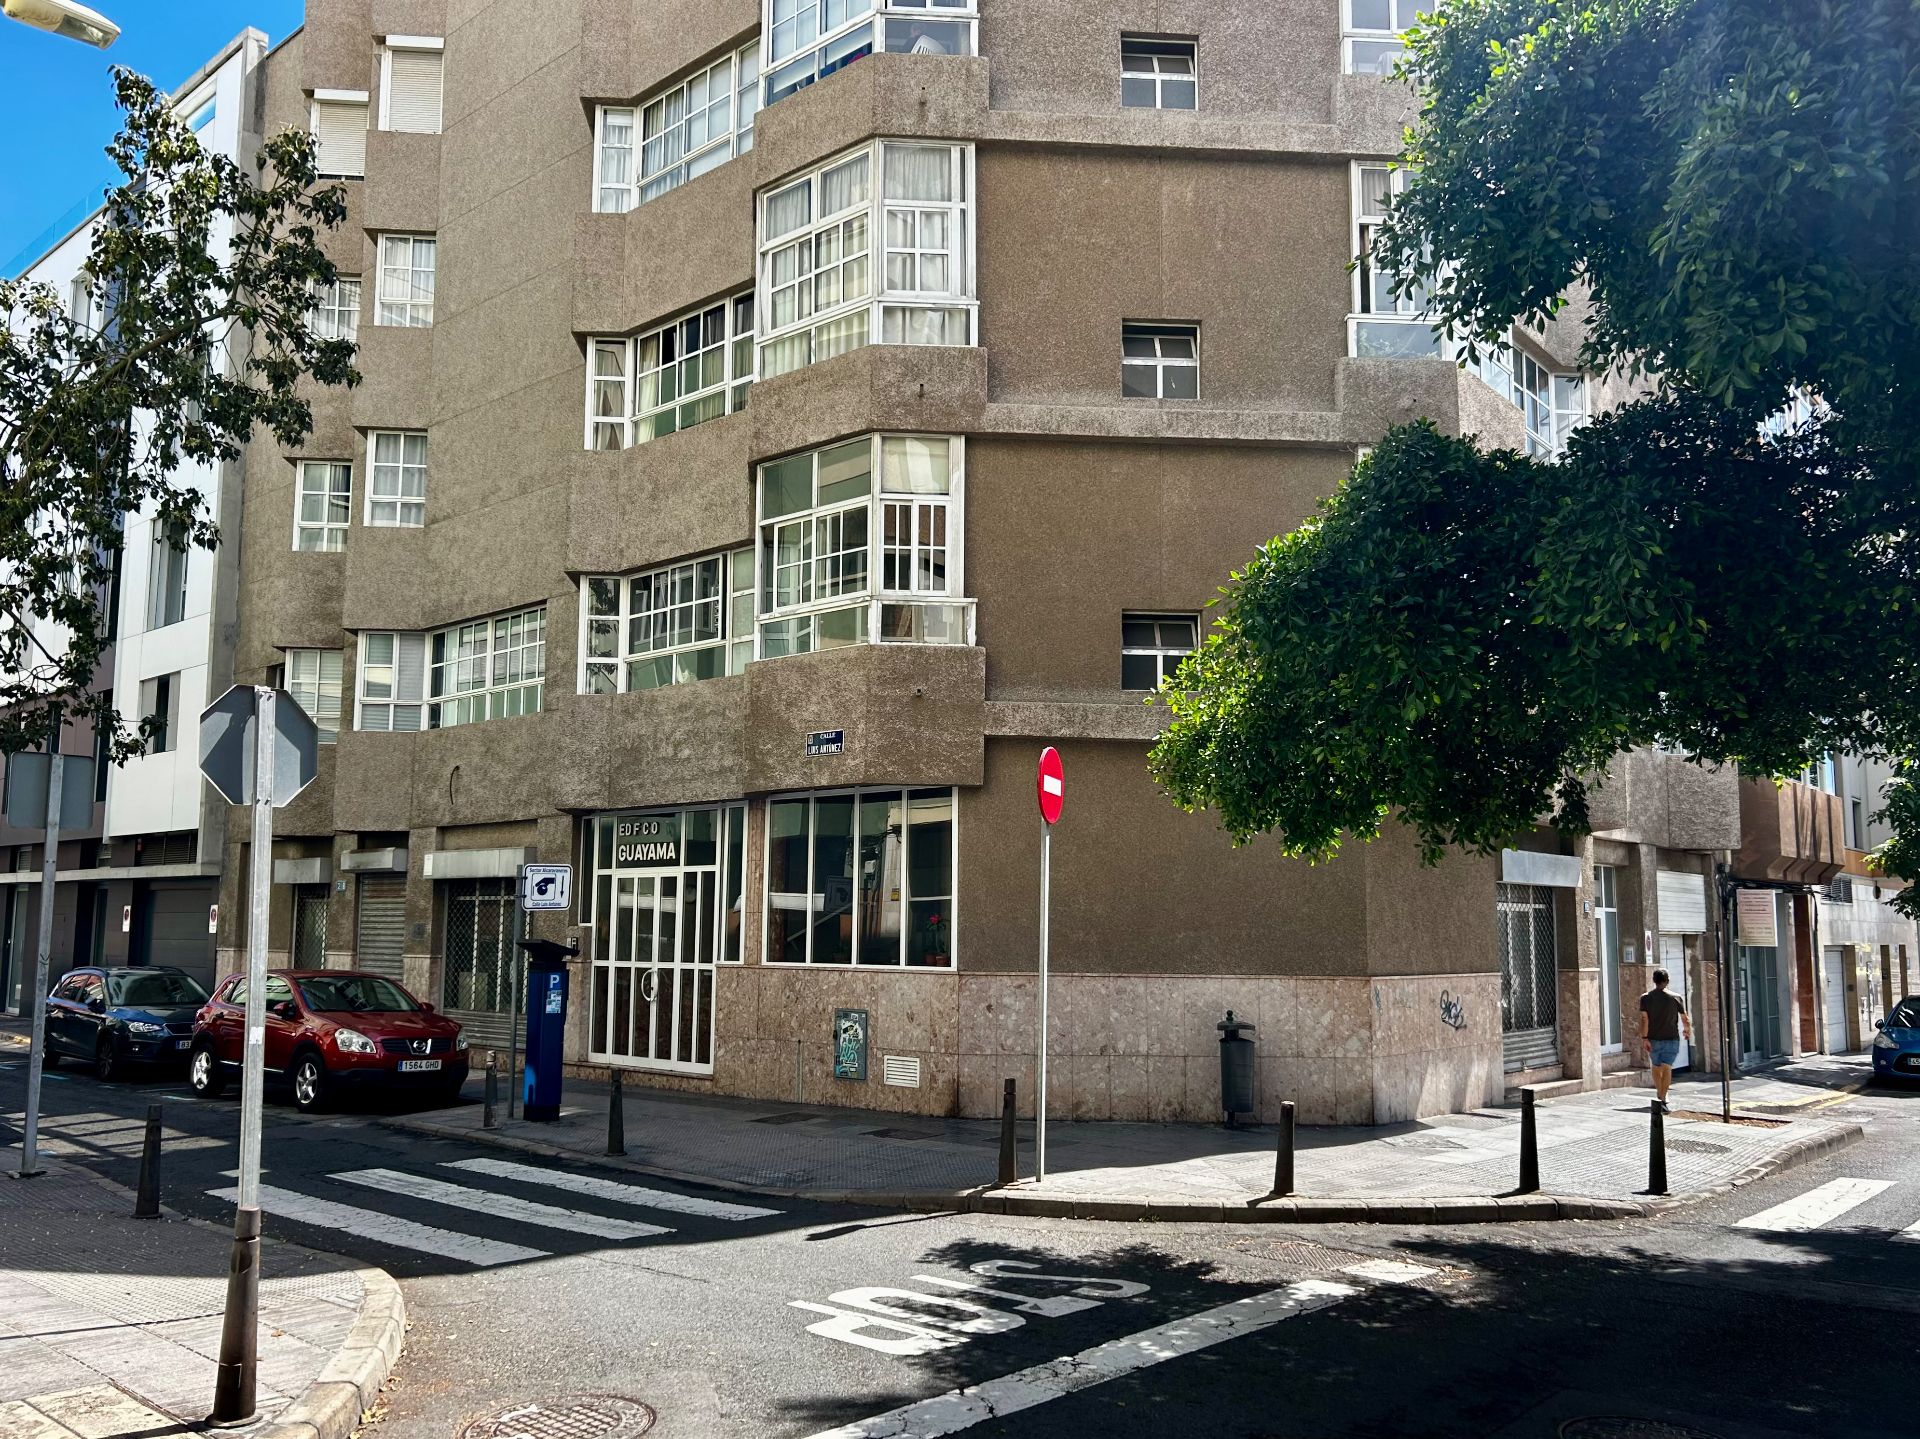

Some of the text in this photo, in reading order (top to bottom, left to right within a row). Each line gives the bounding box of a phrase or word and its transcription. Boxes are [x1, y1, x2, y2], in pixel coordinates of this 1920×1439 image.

[618, 842, 676, 861] GUAYAMA
[550, 974, 560, 988] P
[404, 1061, 423, 1070] 1564
[786, 1259, 1152, 1356] STOP
